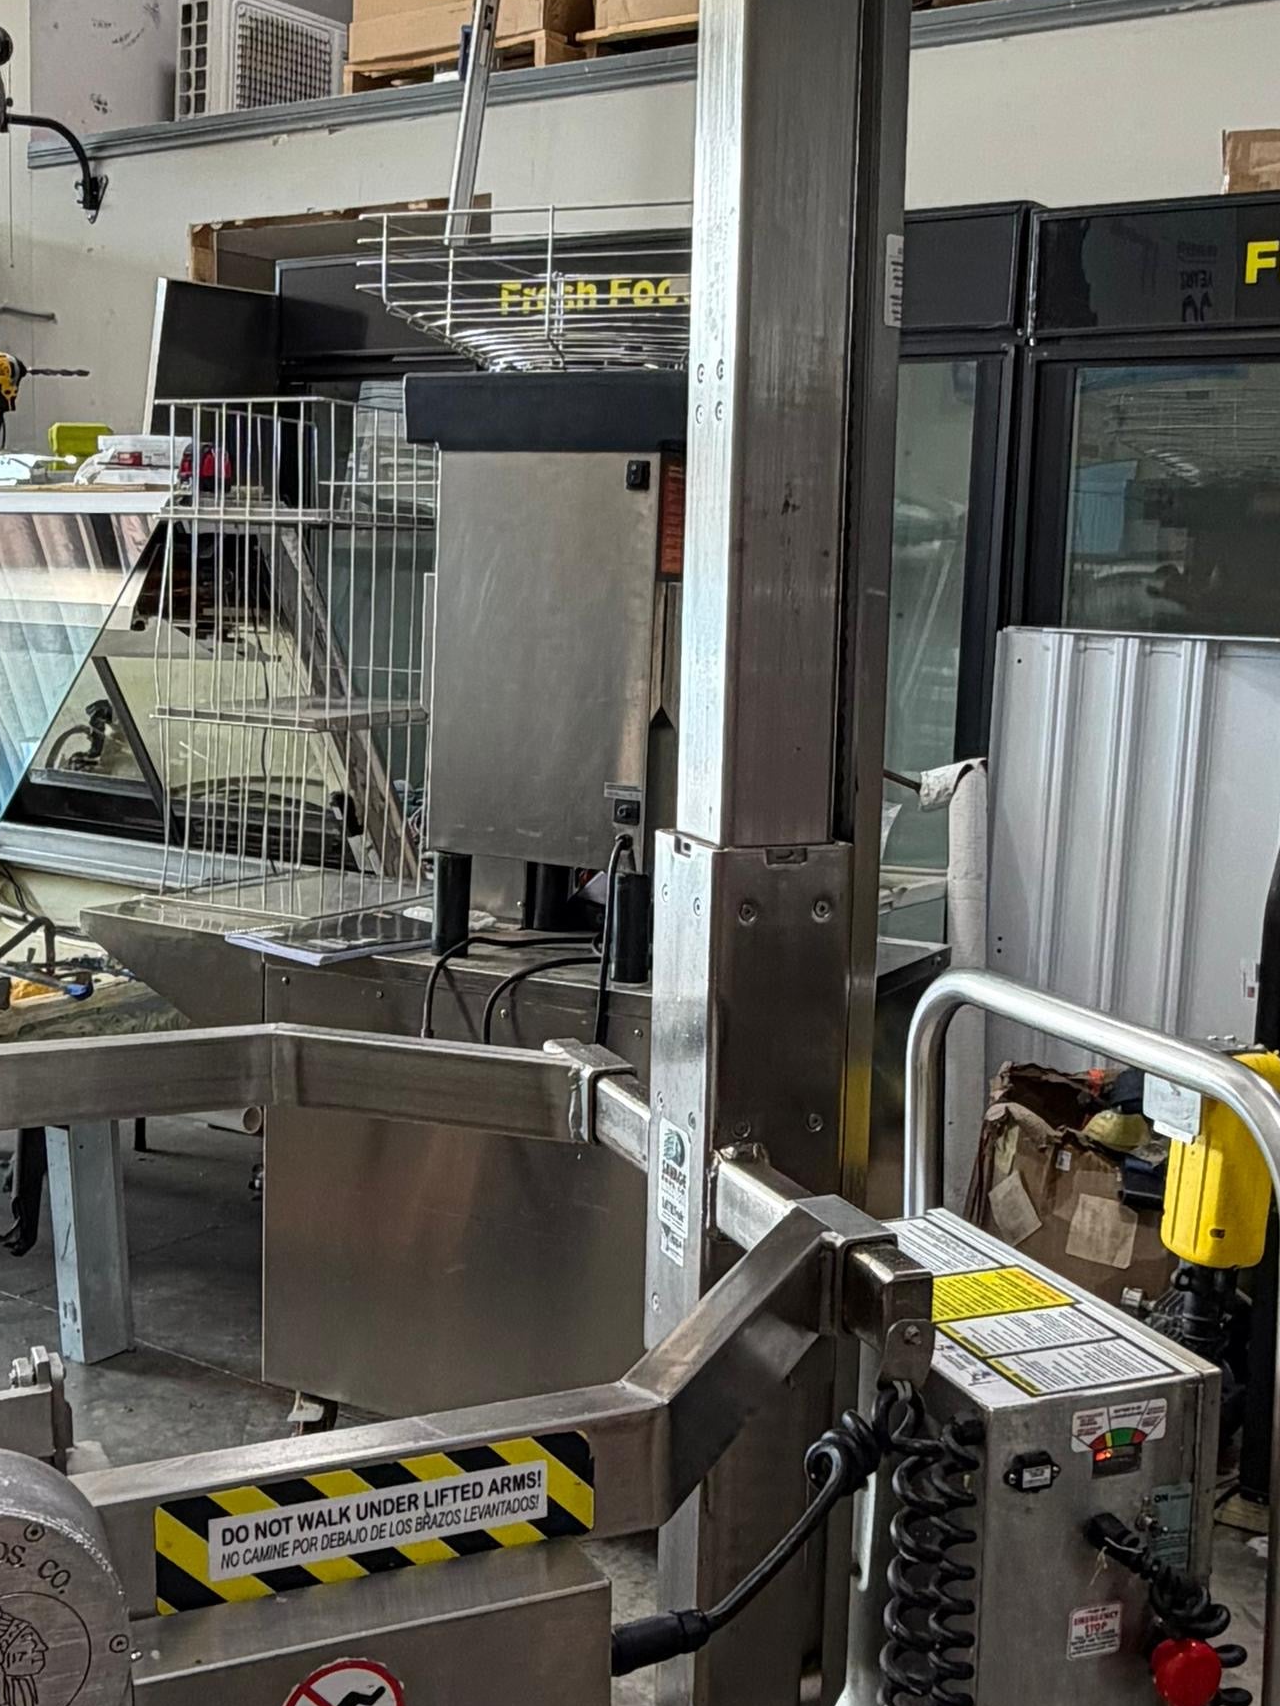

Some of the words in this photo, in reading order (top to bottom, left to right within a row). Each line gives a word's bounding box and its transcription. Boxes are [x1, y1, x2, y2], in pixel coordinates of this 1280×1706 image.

[608, 278, 689, 307] Foo
[220, 1551, 239, 1570] NO
[242, 1541, 290, 1568] CAMINE
[291, 1535, 318, 1556] POR
[320, 1527, 368, 1552] DEBAJO
[370, 1523, 387, 1541] DE
[389, 1518, 413, 1536] LOS
[415, 1507, 462, 1533] BRAZOS
[463, 1494, 540, 1524] LEVANTADOS!
[221, 1523, 249, 1546] DO
[254, 1517, 293, 1540] NOT
[297, 1507, 352, 1533] WALK
[356, 1495, 419, 1522] UNDER
[423, 1481, 484, 1509] LIFTED
[488, 1470, 543, 1496] ARMS!
[36, 1558, 72, 1595] CO.
